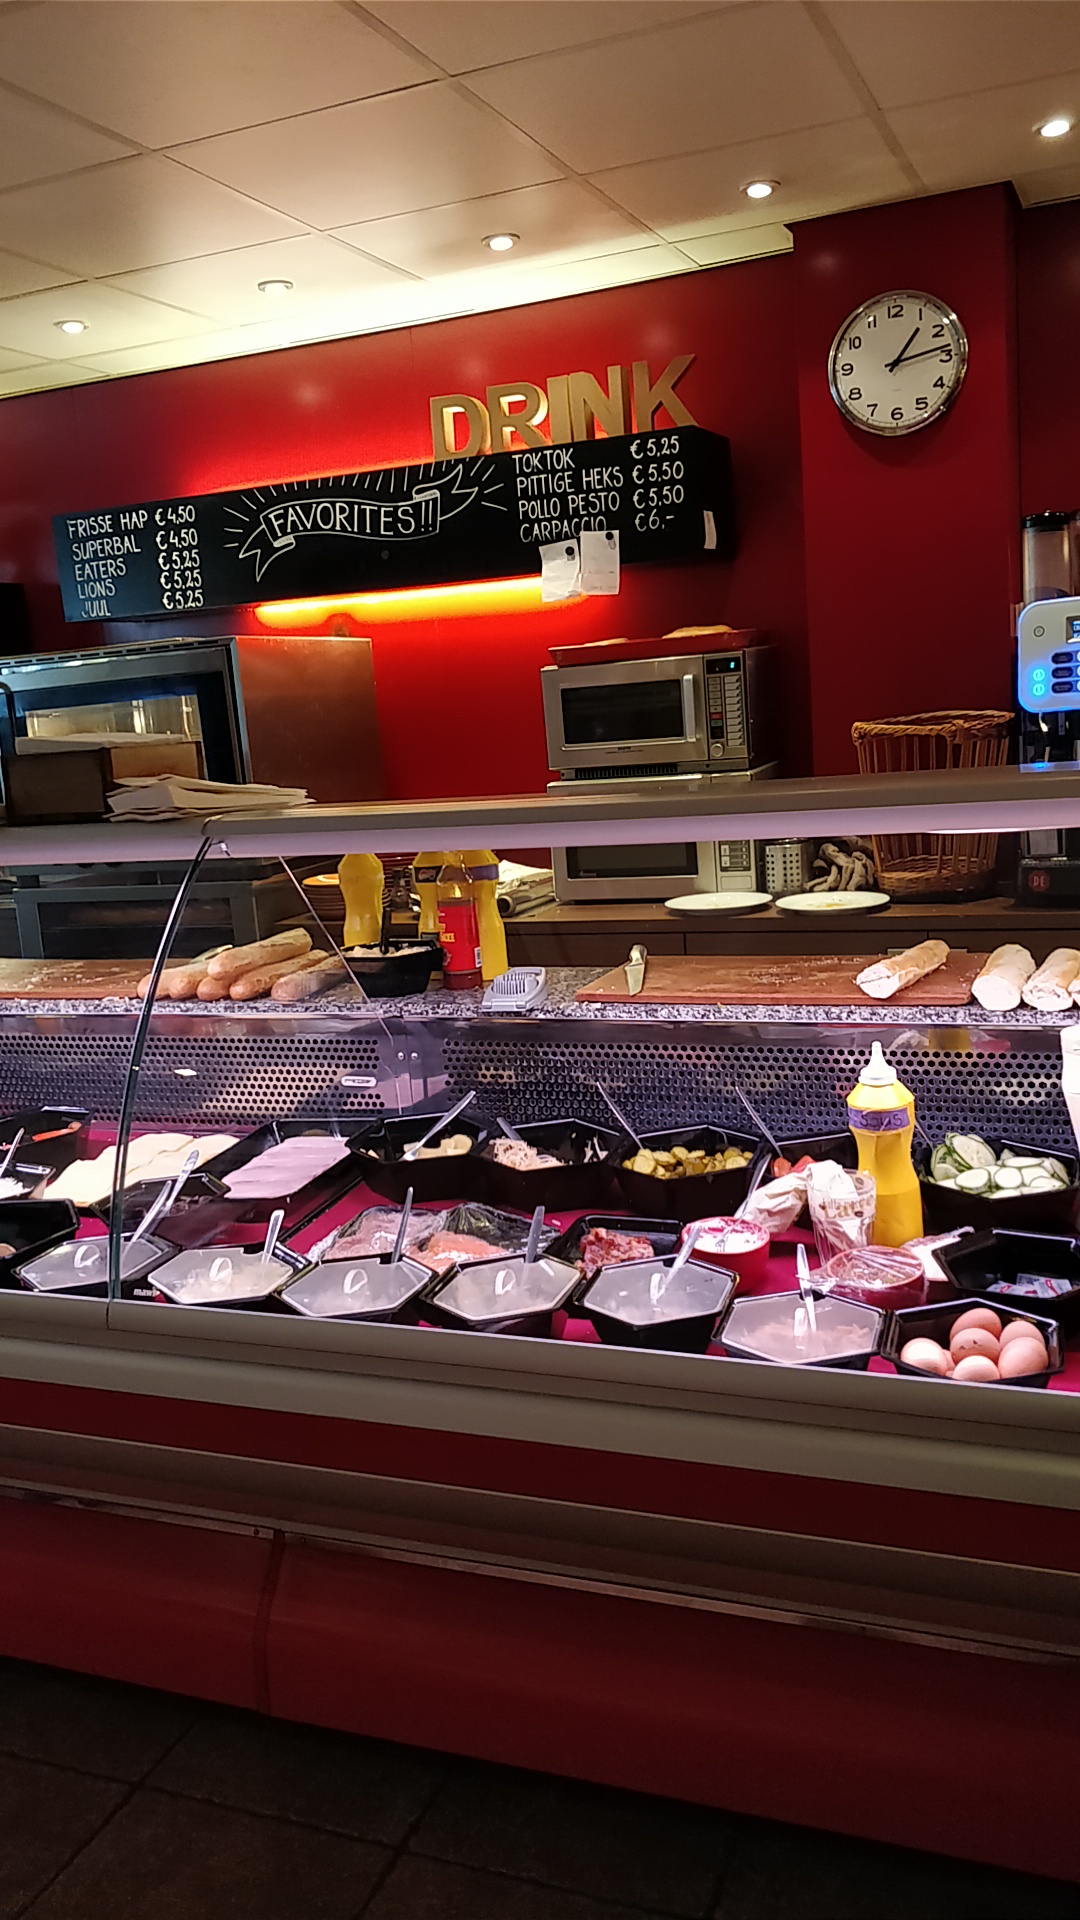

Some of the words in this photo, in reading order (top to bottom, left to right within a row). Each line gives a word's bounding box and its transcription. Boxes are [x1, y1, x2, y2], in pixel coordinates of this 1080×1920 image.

[887, 304, 904, 319] 12
[918, 307, 923, 321] 1
[867, 315, 877, 329] 11
[931, 324, 945, 338] 2
[848, 336, 862, 350] 10
[939, 348, 953, 363] 3
[841, 363, 854, 376] 9
[932, 375, 946, 389] 4
[848, 387, 863, 400] 8
[429, 353, 699, 461] DRINK
[866, 403, 878, 417] 7
[915, 397, 928, 410] 5
[890, 407, 904, 420] 6
[512, 448, 576, 474] TOKTOK
[516, 471, 575, 497] PITTIGE
[582, 466, 625, 490] HEKS
[518, 497, 561, 519] POLLO
[568, 491, 620, 515] PESTO
[66, 515, 114, 539] FRISSE
[120, 509, 148, 531] HAP
[268, 500, 433, 536] FAVORITES!!
[520, 516, 607, 542] CARPACCIO
[72, 534, 142, 561] SUPERBAL
[75, 558, 127, 582] EATERS
[77, 578, 116, 599] LIONS
[81, 599, 112, 618] JUUL
